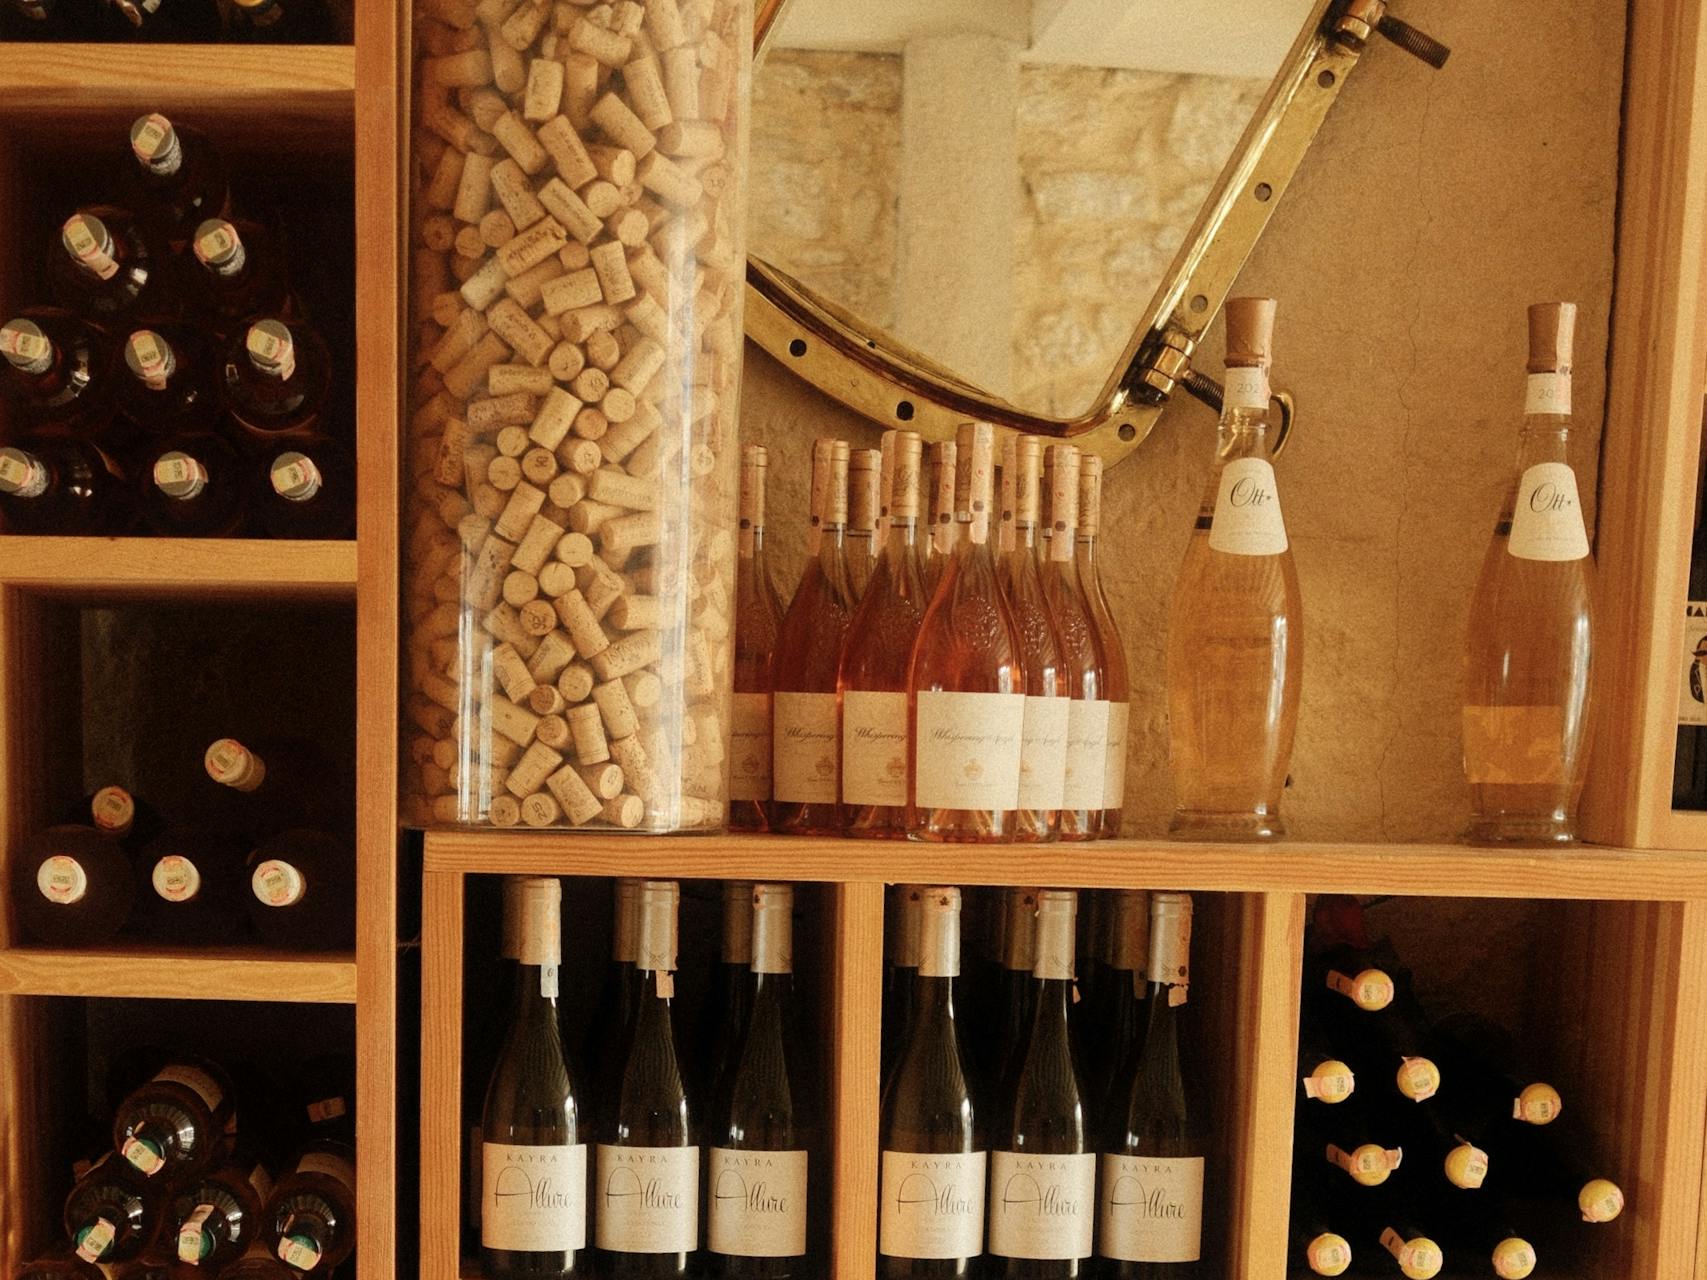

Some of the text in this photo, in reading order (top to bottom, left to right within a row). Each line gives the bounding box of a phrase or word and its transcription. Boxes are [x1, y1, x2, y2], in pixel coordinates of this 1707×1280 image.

[506, 1153, 558, 1163] KAYRA
[617, 1154, 668, 1164] KAYRA
[724, 1157, 773, 1168] KAYRA
[911, 1160, 962, 1169] KAYRA
[1016, 1160, 1067, 1170] KAYRA
[1121, 1163, 1172, 1174] KAYRA
[494, 1166, 573, 1209] Allure
[605, 1166, 683, 1210] Allure
[714, 1169, 788, 1213] Allure
[896, 1172, 974, 1216] Allure
[1000, 1173, 1080, 1217] Allure
[1110, 1175, 1185, 1219] Allure
